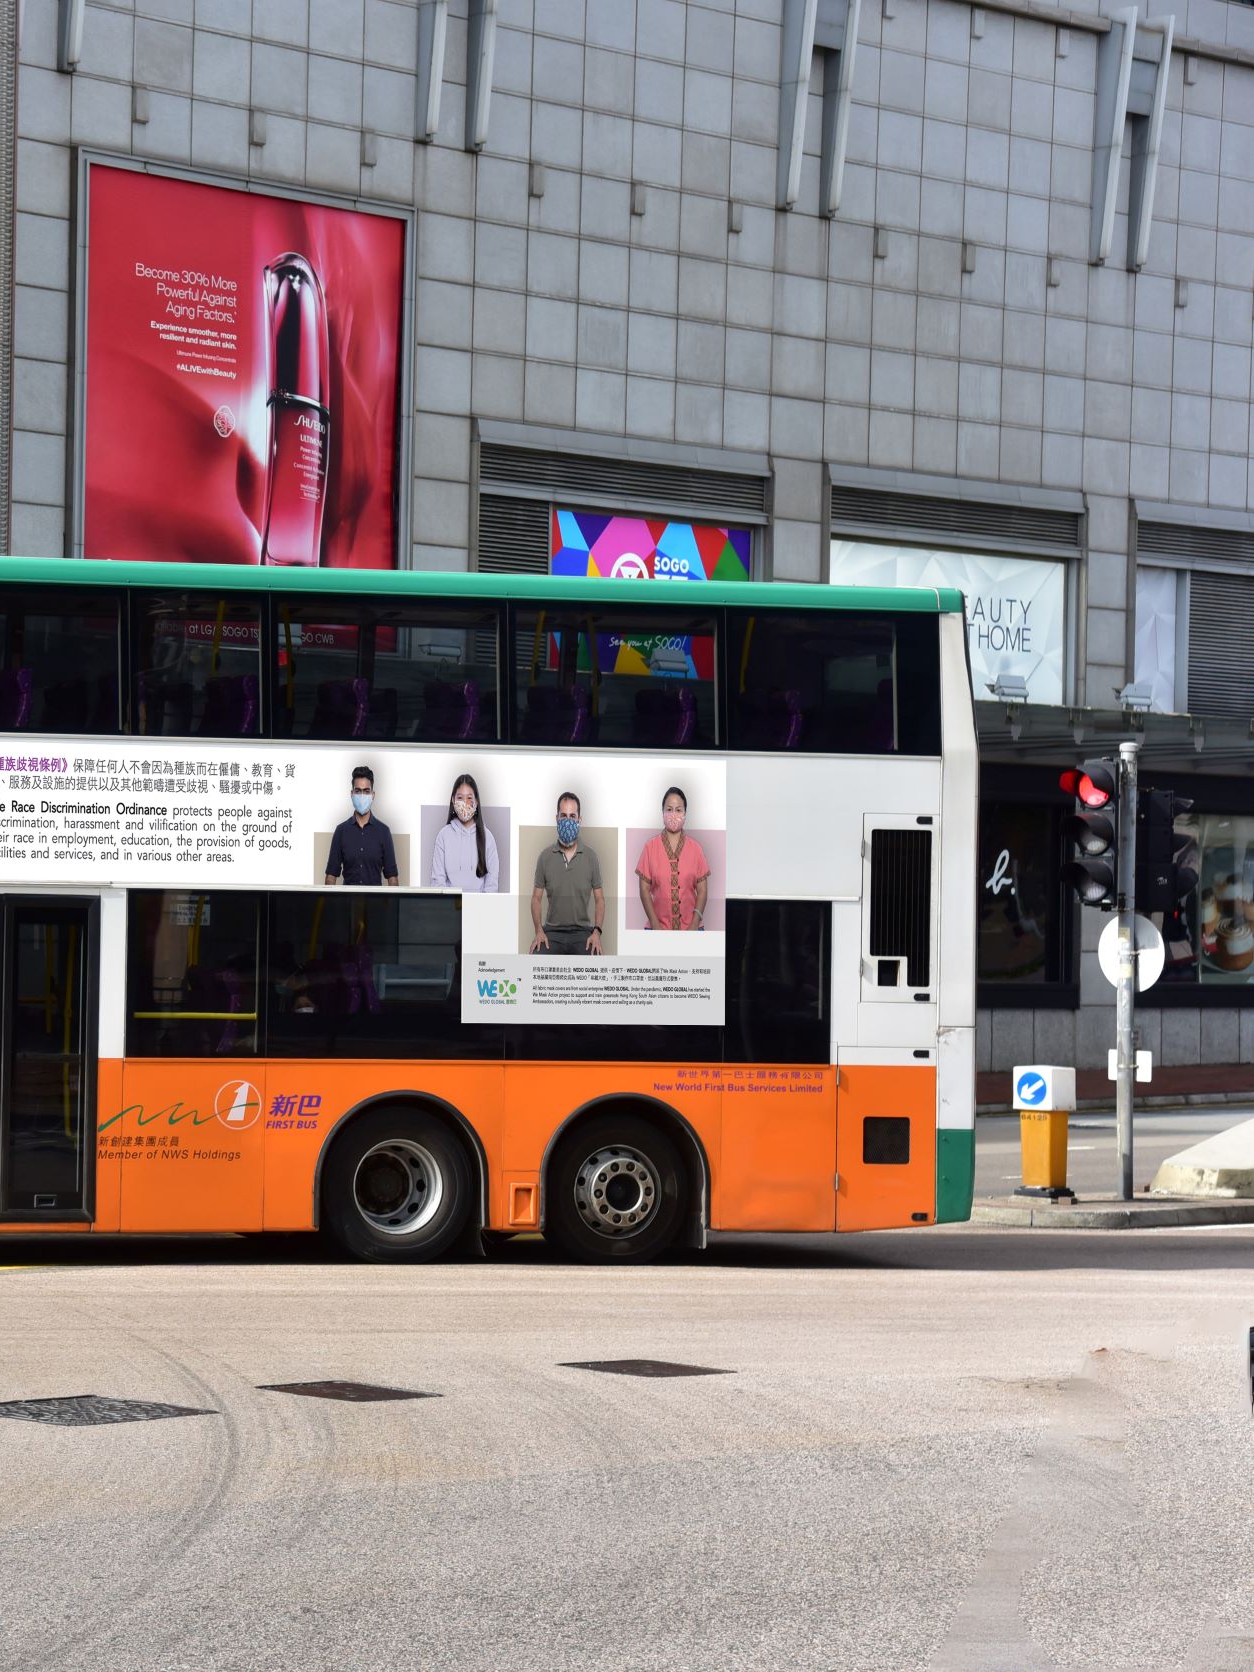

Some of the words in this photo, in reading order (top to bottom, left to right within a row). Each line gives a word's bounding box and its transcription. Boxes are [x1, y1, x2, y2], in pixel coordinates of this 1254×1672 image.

[135, 262, 179, 281] Become
[181, 270, 209, 287] 30%
[212, 276, 237, 291] More
[157, 283, 199, 301] Powerful
[201, 292, 236, 308] Against
[166, 301, 195, 319] Aging
[151, 321, 187, 333] Experience
[188, 327, 219, 338] smoother,
[160, 333, 185, 342] resilient
[200, 339, 221, 348] radiant
[177, 364, 236, 379] #ALIVEwithBeauty
[654, 556, 689, 574] SOGO
[965, 596, 1031, 625] AUTY
[189, 624, 198, 634] at
[223, 625, 249, 638] SOGO
[250, 628, 259, 638] TS
[315, 633, 334, 644] CWB
[978, 624, 1031, 652] HOME
[609, 637, 625, 647] See
[627, 640, 642, 650] you
[11, 799, 36, 814] Race
[40, 800, 111, 815] Discrimination
[115, 801, 168, 816] Ordinance
[172, 806, 213, 820] protects
[217, 804, 253, 821] people
[257, 808, 293, 822] against
[64, 816, 121, 830] harassment
[125, 817, 144, 831] and
[148, 817, 198, 832] vilification
[202, 823, 216, 832] on
[220, 819, 237, 833] the
[241, 820, 277, 836] ground
[282, 820, 293, 834] of
[13, 834, 35, 844] race
[38, 831, 48, 844] in
[51, 831, 117, 849] employment,
[120, 832, 173, 848] education,
[176, 833, 193, 847] the
[196, 838, 241, 851] provision
[244, 834, 255, 848] of
[258, 836, 292, 852] goods,
[30, 846, 50, 859] and
[54, 847, 96, 862] services,
[100, 847, 119, 861] and
[123, 848, 133, 861] in
[136, 849, 172, 862] various
[175, 849, 203, 862] other
[206, 853, 235, 863] areas.
[677, 1070, 824, 1080] 新世界第一巴士服務有限公司
[654, 1083, 672, 1091] New
[675, 1083, 702, 1092] World
[705, 1083, 724, 1092] First
[728, 1084, 745, 1092] Bus
[748, 1084, 786, 1093] Services
[789, 1084, 823, 1093] Limited
[269, 1094, 322, 1117] 新巴
[266, 1120, 295, 1129] FIRST
[296, 1120, 317, 1129] BUS
[97, 1135, 180, 1147] 新創建集團成員
[98, 1149, 143, 1159] Member
[146, 1149, 158, 1159] of
[161, 1149, 189, 1159] NWS
[192, 1150, 241, 1162] Holdings
